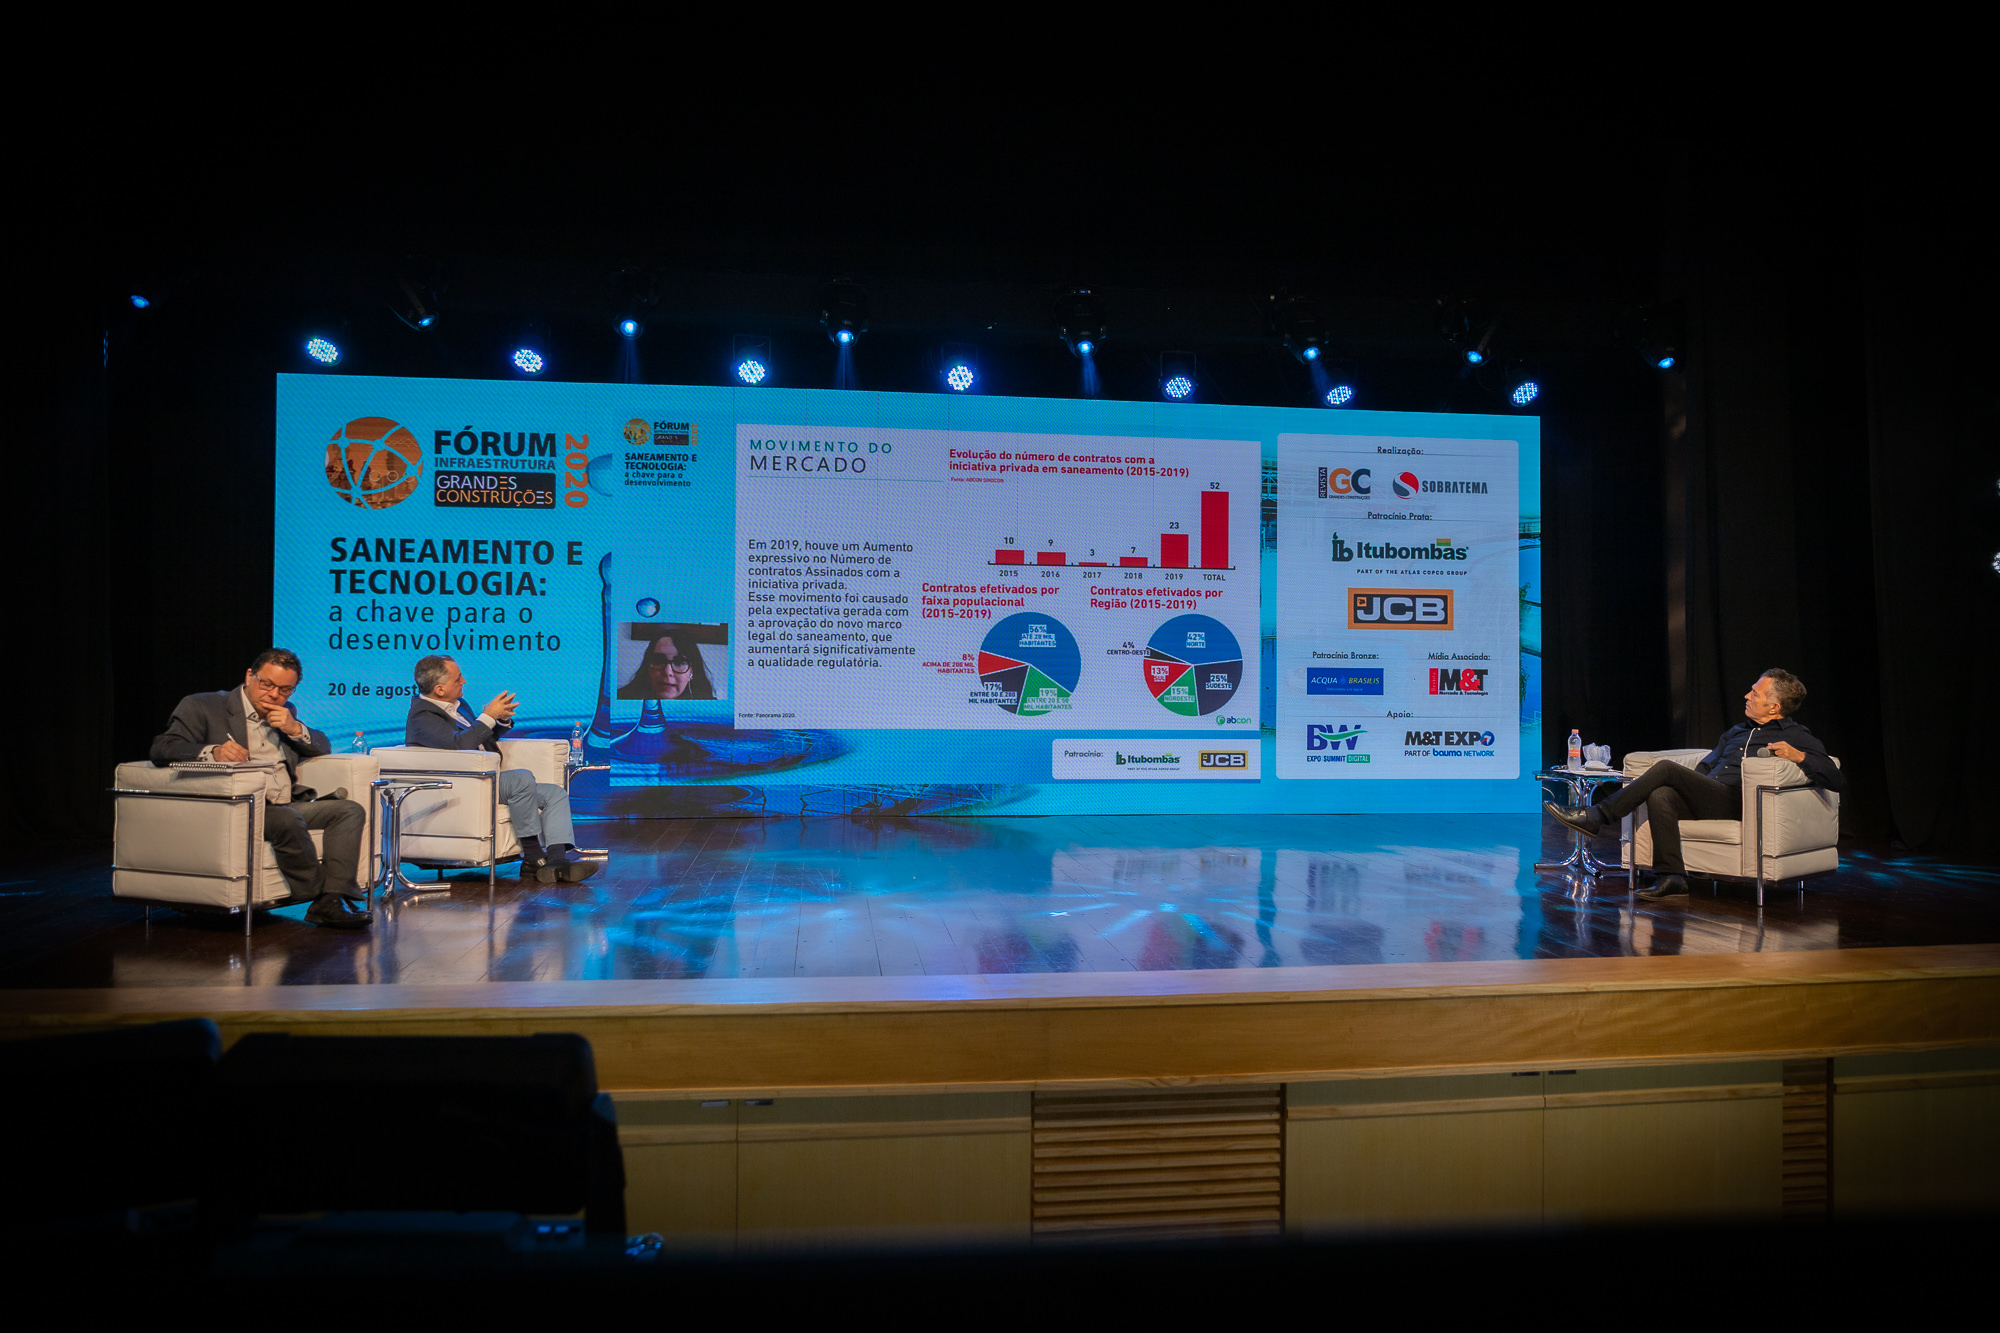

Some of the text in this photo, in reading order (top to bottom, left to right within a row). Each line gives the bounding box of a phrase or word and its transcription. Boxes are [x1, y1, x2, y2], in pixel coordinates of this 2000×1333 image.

[654, 421, 689, 430] FÓRUM
[435, 425, 556, 457] FÓRUM
[750, 439, 892, 454] MOVIMENTO DO
[625, 453, 697, 462] SANEAMENTO E
[950, 449, 996, 461] Evolução
[1000, 451, 1012, 460] do
[1015, 451, 1055, 462] número
[1058, 453, 1070, 462] de
[1073, 454, 1122, 464] contratos
[1125, 456, 1146, 464] com
[1378, 447, 1423, 456] Realização:
[435, 458, 556, 469] INFRAESTRUTURA
[625, 462, 686, 471] TECNOLOGIA:
[751, 455, 866, 473] MERCADO
[949, 461, 1189, 478] iniciativa privada em saneamento (2015-2019)
[564, 433, 589, 508] 2020
[437, 475, 517, 489] GRANDES
[625, 479, 690, 487] desenvolvimento
[658, 473, 674, 481] para
[1329, 468, 1370, 494] GC
[1422, 481, 1488, 494] SOBRATEMA
[436, 489, 553, 506] CONSTRUÇÕES
[1368, 512, 1406, 520] Patrocínio
[331, 537, 583, 565] SANEAMENTO E
[749, 540, 913, 552] Em 2019, houve um Aumento
[1357, 542, 1467, 560] Itubombas
[748, 553, 809, 564] expressivo
[830, 554, 875, 564] Número
[878, 555, 891, 564] de
[748, 567, 802, 576] contratos
[806, 567, 863, 577] Assinados
[867, 569, 890, 577] com
[330, 569, 546, 596] TECNOLOGIA:
[748, 579, 847, 591] iniciativa privada.
[922, 583, 1060, 596] Contratos efetivados por
[1090, 586, 1223, 599] Contratos efetivados por
[749, 592, 908, 603] Esse movimento foi causado
[922, 596, 1024, 607] faixa populacional
[1091, 599, 1197, 610] Região (2015-2019)
[1357, 597, 1445, 621] JCB
[329, 599, 533, 628] a chave para o
[748, 605, 908, 618] pela expectativa gerada com
[922, 608, 991, 619] (2015-2019)
[758, 618, 816, 630] aprovação
[820, 618, 833, 628] do
[838, 620, 863, 628] novo
[867, 621, 902, 629] marco
[329, 626, 561, 651] desenvolvimento
[748, 631, 892, 643] legal do saneamento, que
[748, 644, 916, 656] aumentará significativamente
[1313, 652, 1379, 660] Patrocínio Bronze:
[758, 657, 813, 669] qualidade
[817, 657, 882, 669] regulatória.
[1453, 653, 1490, 661] Associada:
[1311, 677, 1338, 685] ACQUA
[1439, 669, 1488, 691] M&T
[328, 682, 417, 699] 20 de agost
[1387, 711, 1413, 719] Apoio:
[1307, 725, 1361, 750] BW
[1064, 750, 1103, 758] Patrocínio:
[1128, 755, 1180, 763] Itubombas
[1203, 754, 1244, 766] JCB
